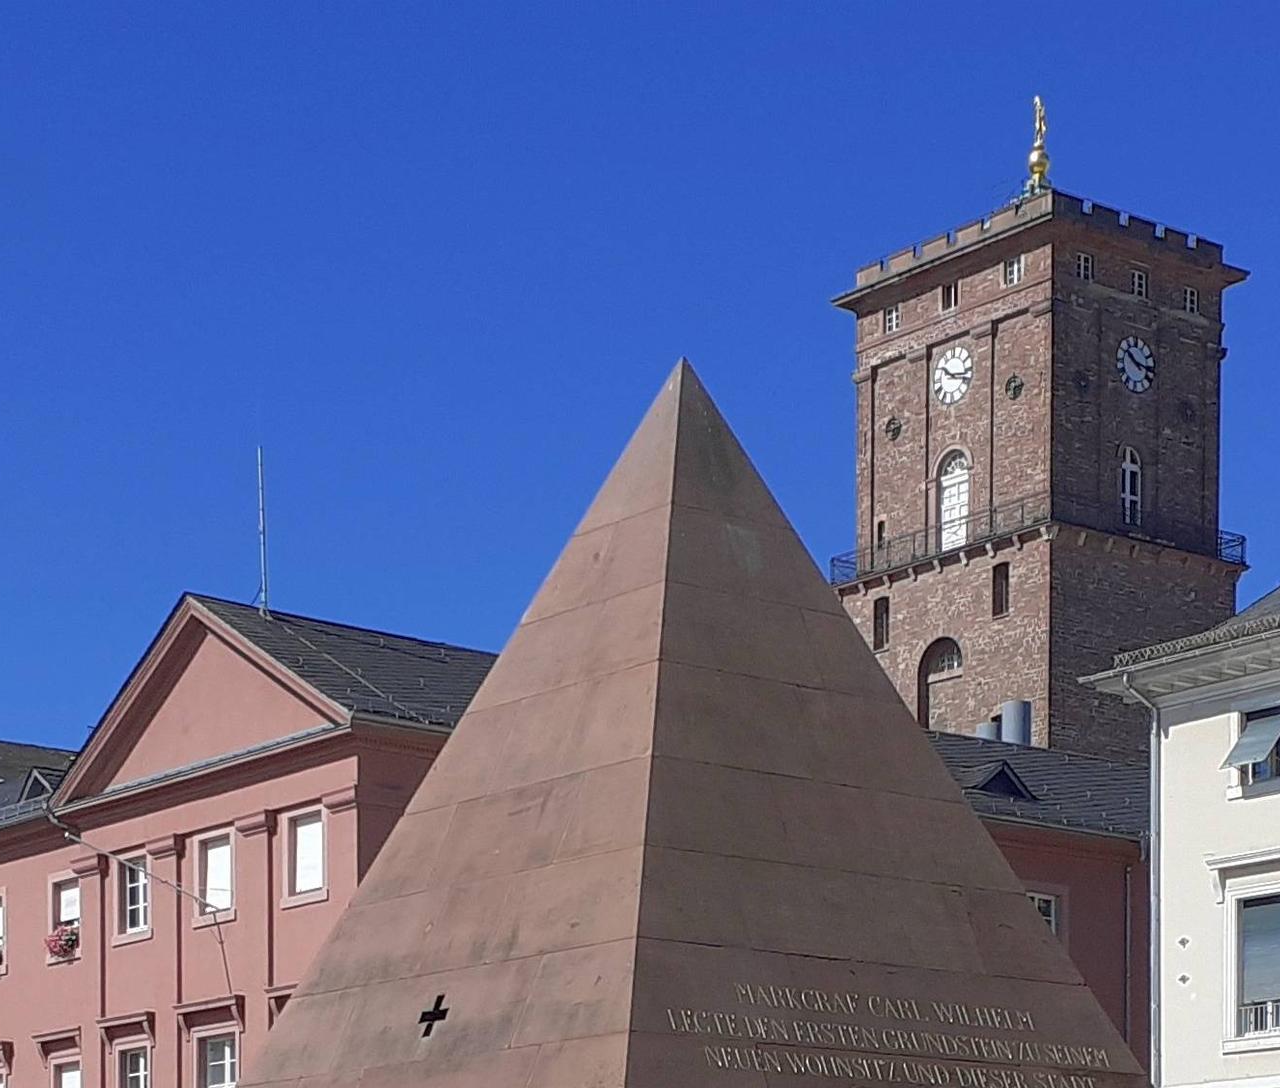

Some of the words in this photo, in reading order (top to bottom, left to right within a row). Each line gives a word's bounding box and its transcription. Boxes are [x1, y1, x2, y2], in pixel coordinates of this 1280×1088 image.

[734, 982, 859, 1015] MARKGRAF
[867, 995, 929, 1022] CARL
[932, 1001, 1036, 1031] WILHELM
[704, 1045, 782, 1073] NEUEN
[784, 1050, 902, 1083] WOHNSITZ
[902, 1061, 951, 1085] UND
[744, 1015, 789, 1041] DEN
[792, 1020, 880, 1049] ERSTEN
[881, 1028, 1014, 1060] GRUNDSTEIN
[1044, 1043, 1111, 1068] SEINEM
